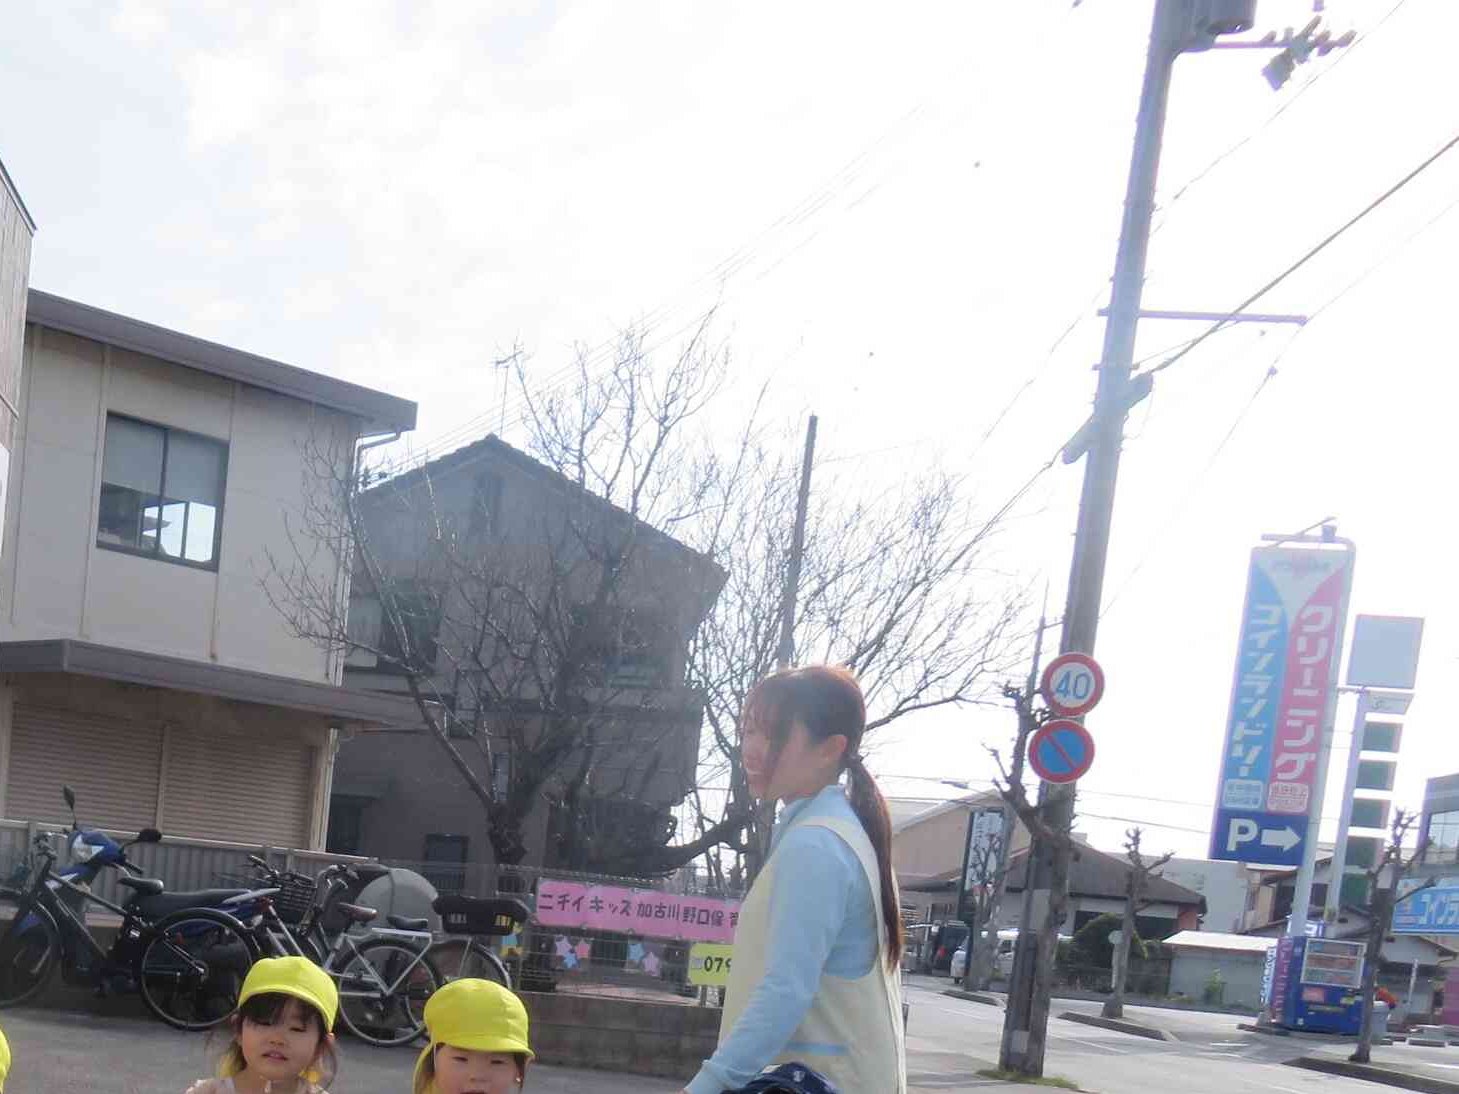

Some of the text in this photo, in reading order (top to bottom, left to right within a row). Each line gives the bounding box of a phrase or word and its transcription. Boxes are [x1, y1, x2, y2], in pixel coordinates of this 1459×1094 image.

[1055, 670, 1091, 700] 40
[1231, 605, 1280, 777] コインランドリー
[1275, 606, 1333, 780] クリーニング
[1226, 818, 1259, 852] P
